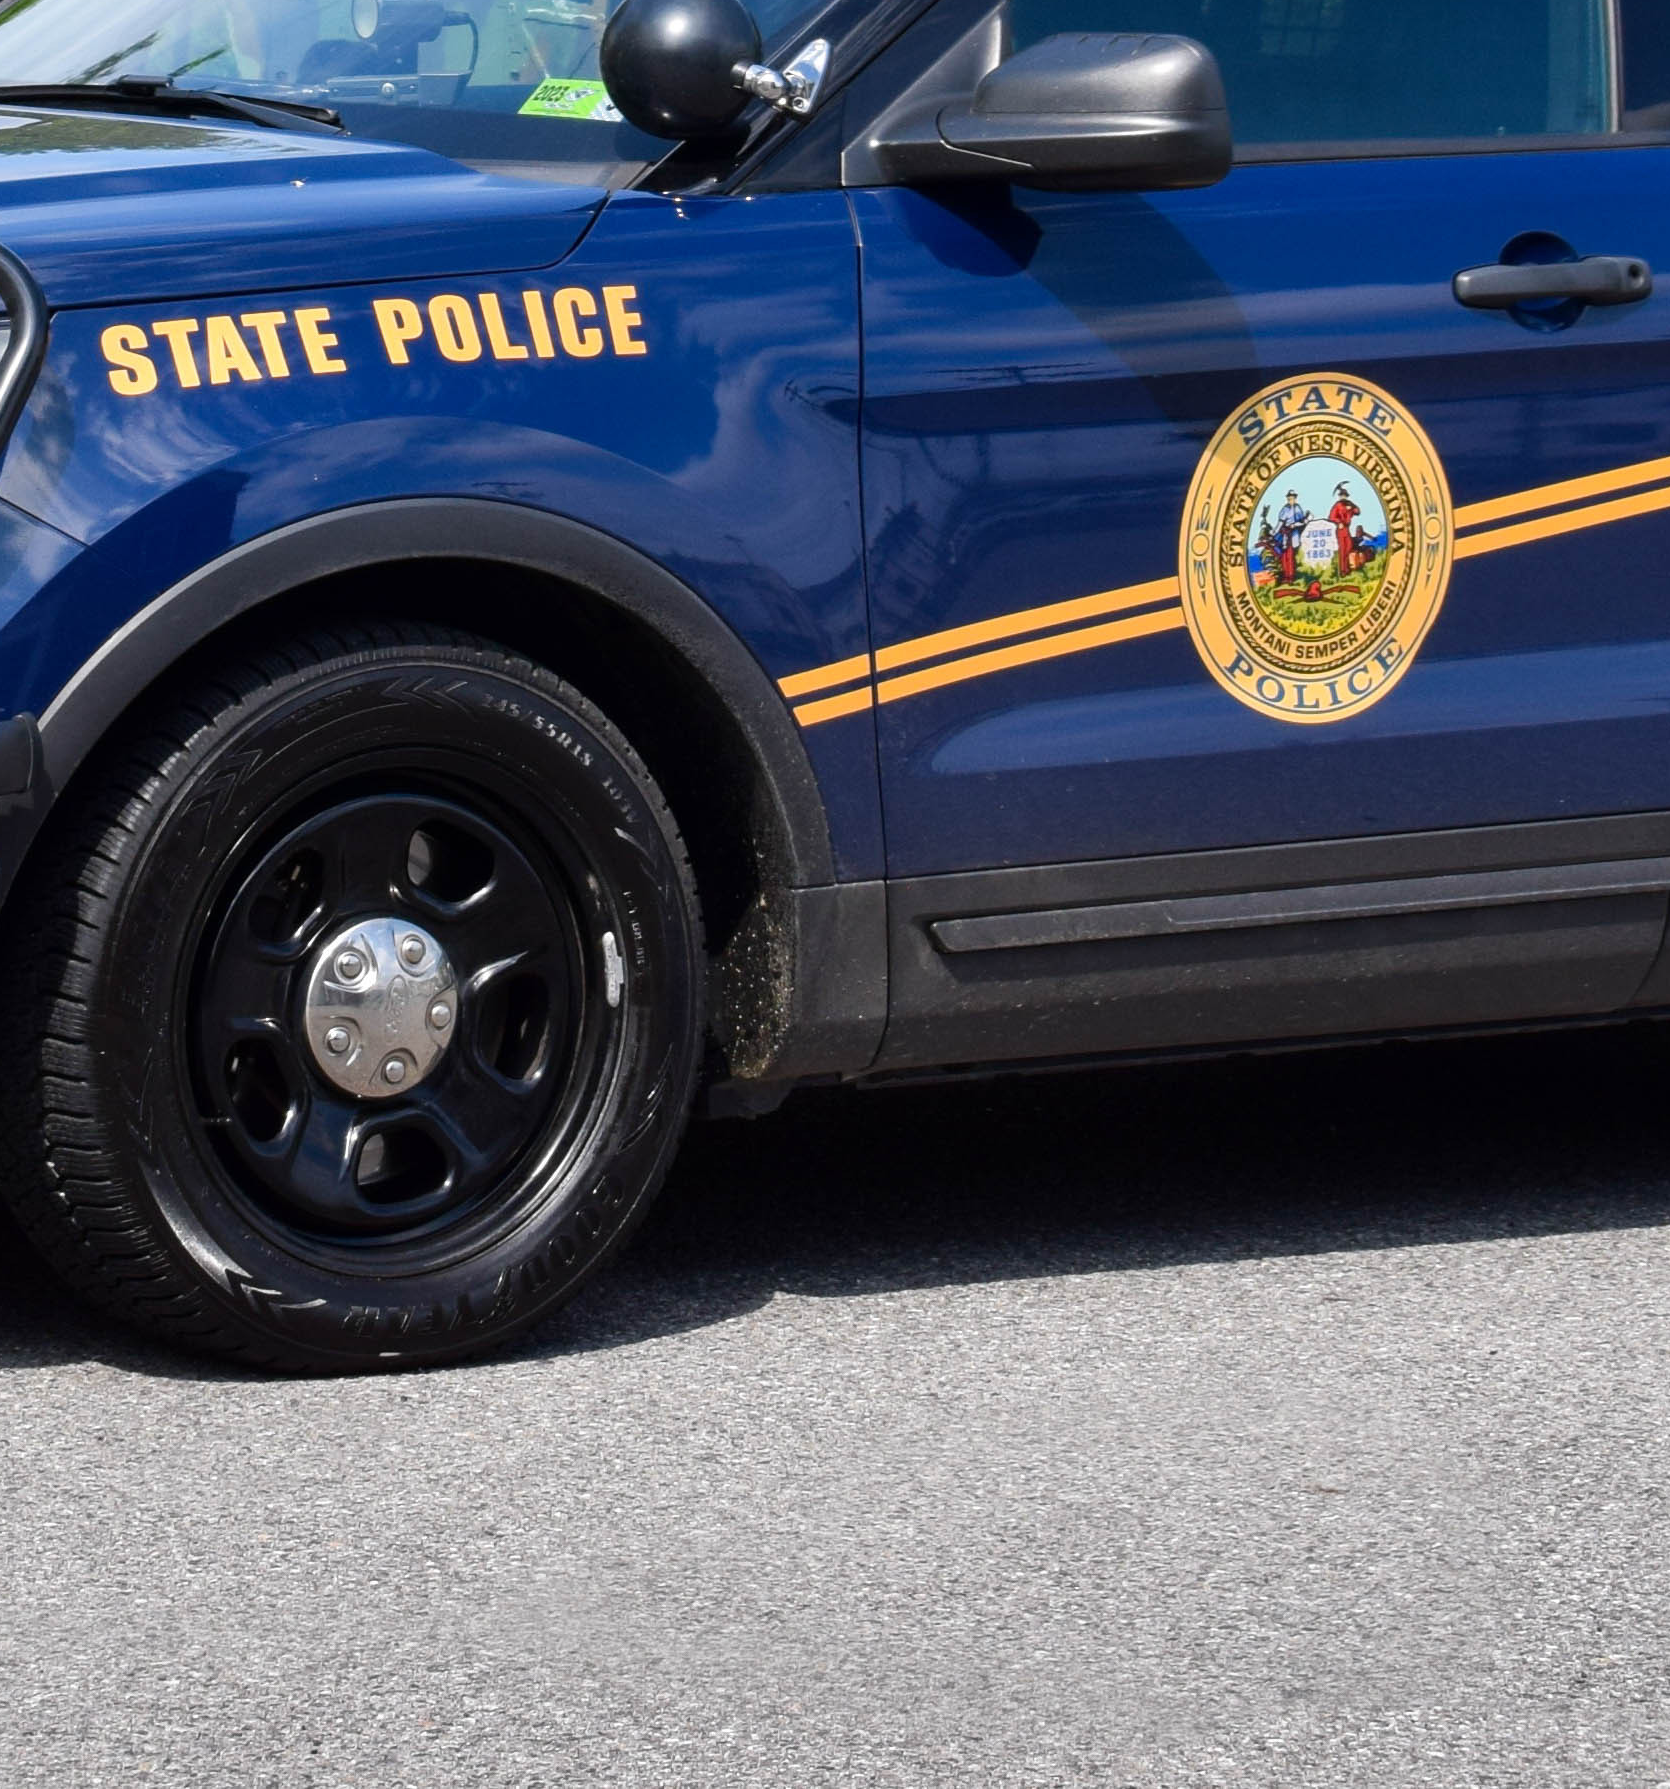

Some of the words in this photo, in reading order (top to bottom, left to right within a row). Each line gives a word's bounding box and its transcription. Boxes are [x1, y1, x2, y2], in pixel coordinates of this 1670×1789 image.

[100, 307, 347, 396] STATE
[372, 285, 647, 364] POLICE
[1238, 385, 1396, 445] STATE
[1229, 484, 1258, 567] STATE
[1258, 451, 1282, 481] OF
[1287, 434, 1348, 461] WEST
[1353, 441, 1407, 554] VIRGINIA
[1306, 528, 1332, 539] JUNE
[1306, 549, 1332, 559] 1863
[1312, 539, 1327, 549] 20
[1236, 591, 1290, 656] MONTANI
[1295, 632, 1359, 659] SEMPER
[1363, 580, 1397, 635] LIBERI
[1224, 637, 1406, 709] POLICE
